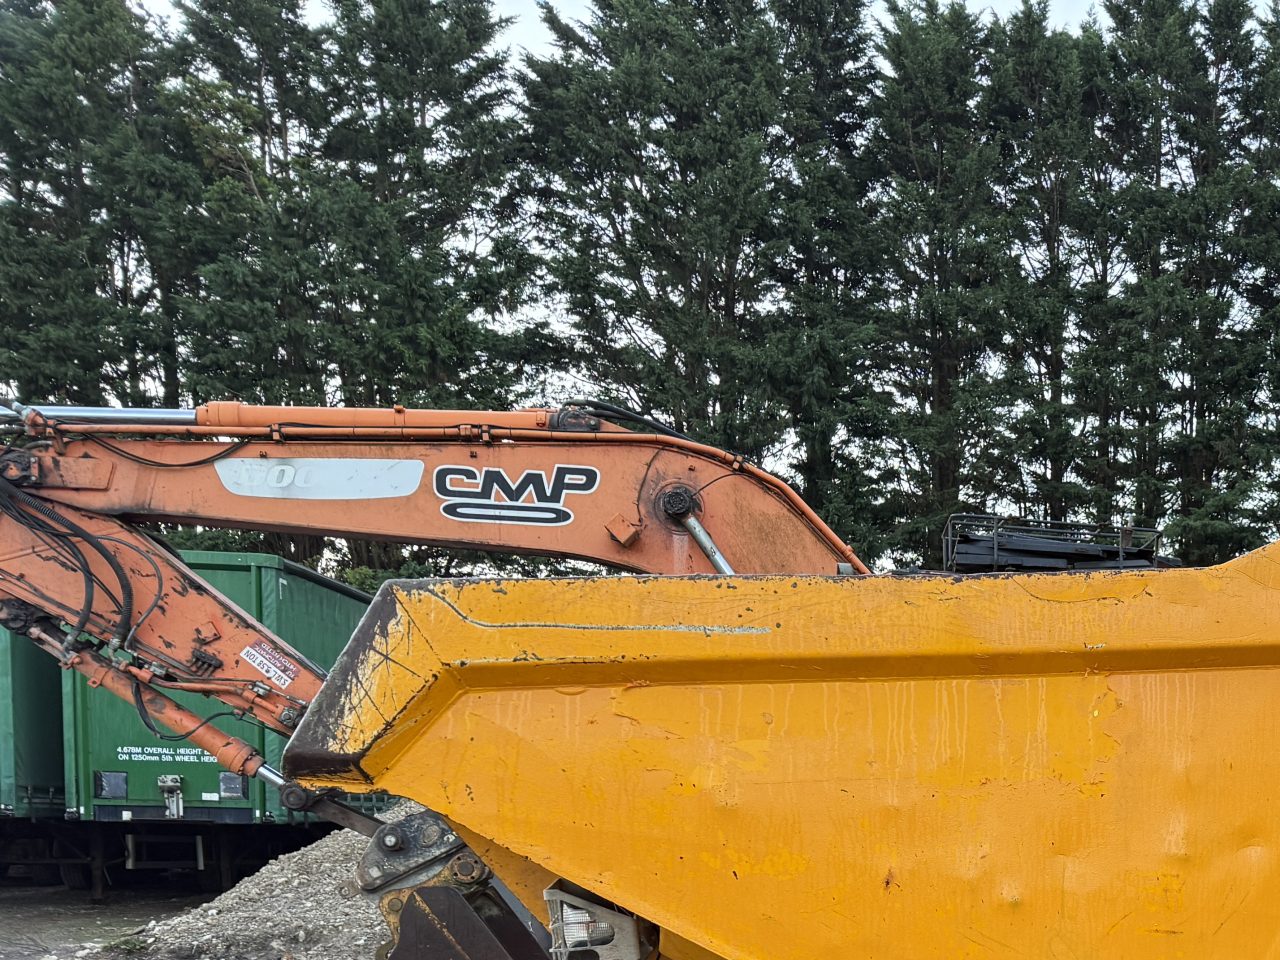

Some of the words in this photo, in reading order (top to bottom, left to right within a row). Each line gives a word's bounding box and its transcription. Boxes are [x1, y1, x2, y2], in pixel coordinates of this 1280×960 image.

[434, 464, 599, 505] CMP
[117, 746, 142, 754] 4.678M
[144, 747, 175, 755] OVERALL
